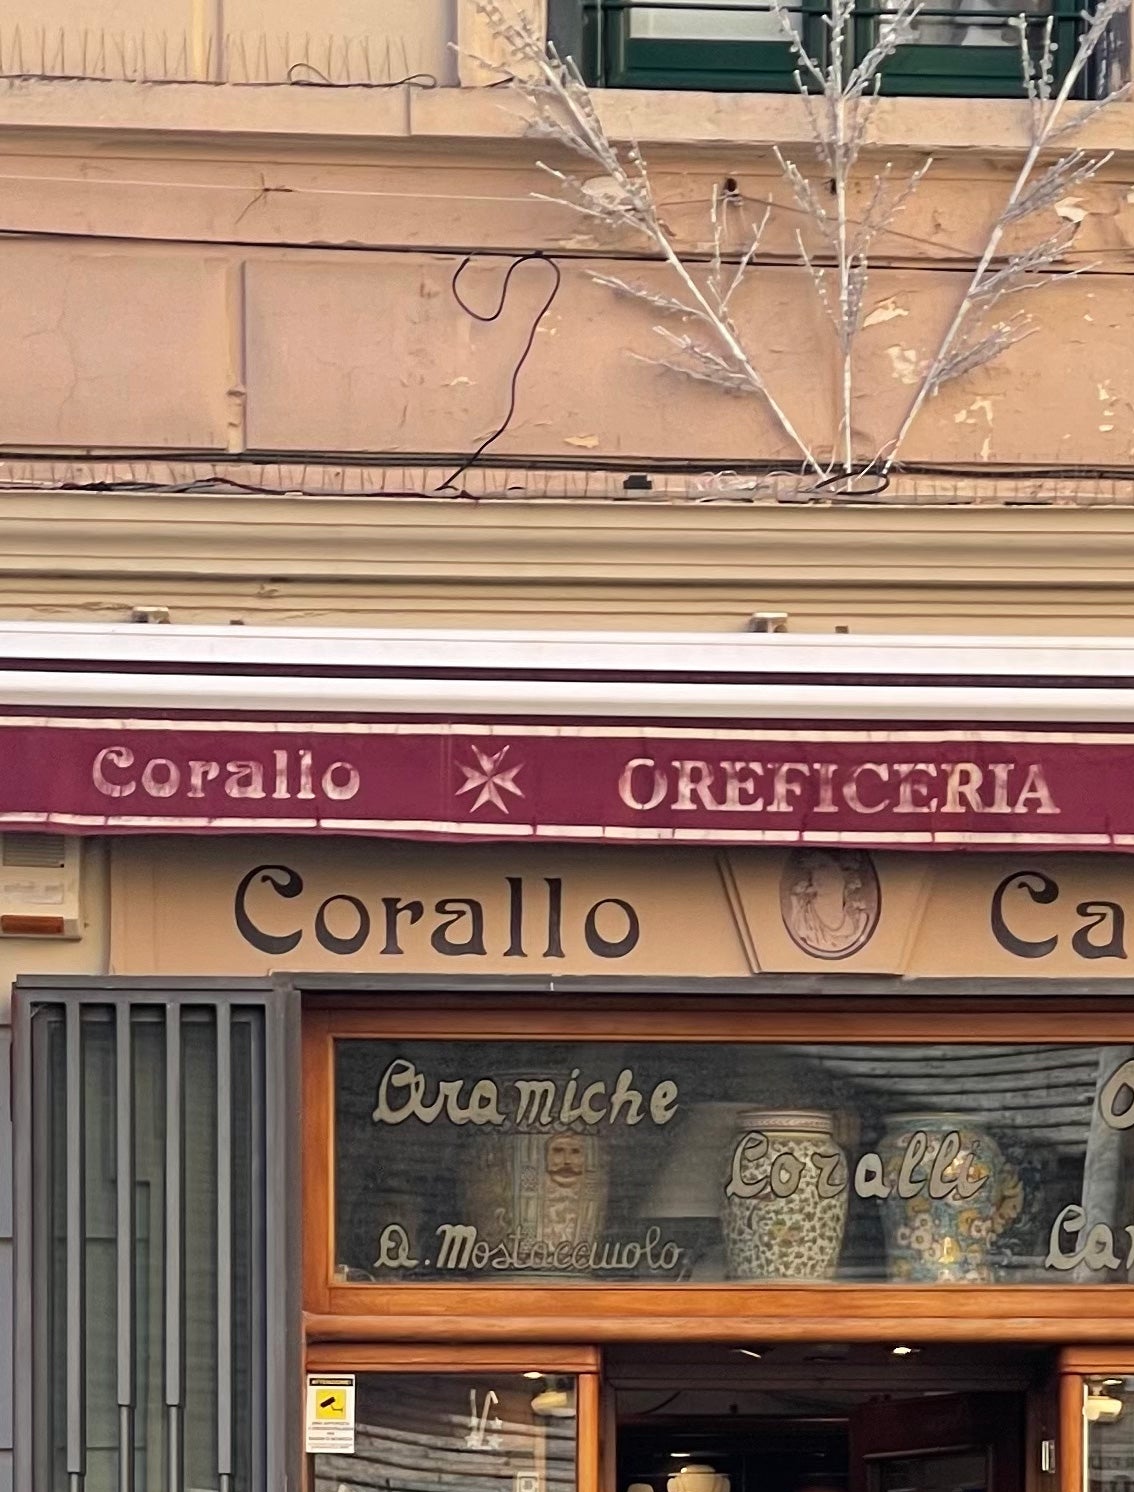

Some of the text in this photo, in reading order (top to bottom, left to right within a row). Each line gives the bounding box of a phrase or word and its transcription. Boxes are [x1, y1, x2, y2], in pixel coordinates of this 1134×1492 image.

[92, 746, 361, 801] Corallo
[618, 757, 1061, 815] OREFICERIA
[235, 864, 641, 959] Corallo
[726, 1130, 990, 1200] Coralli
